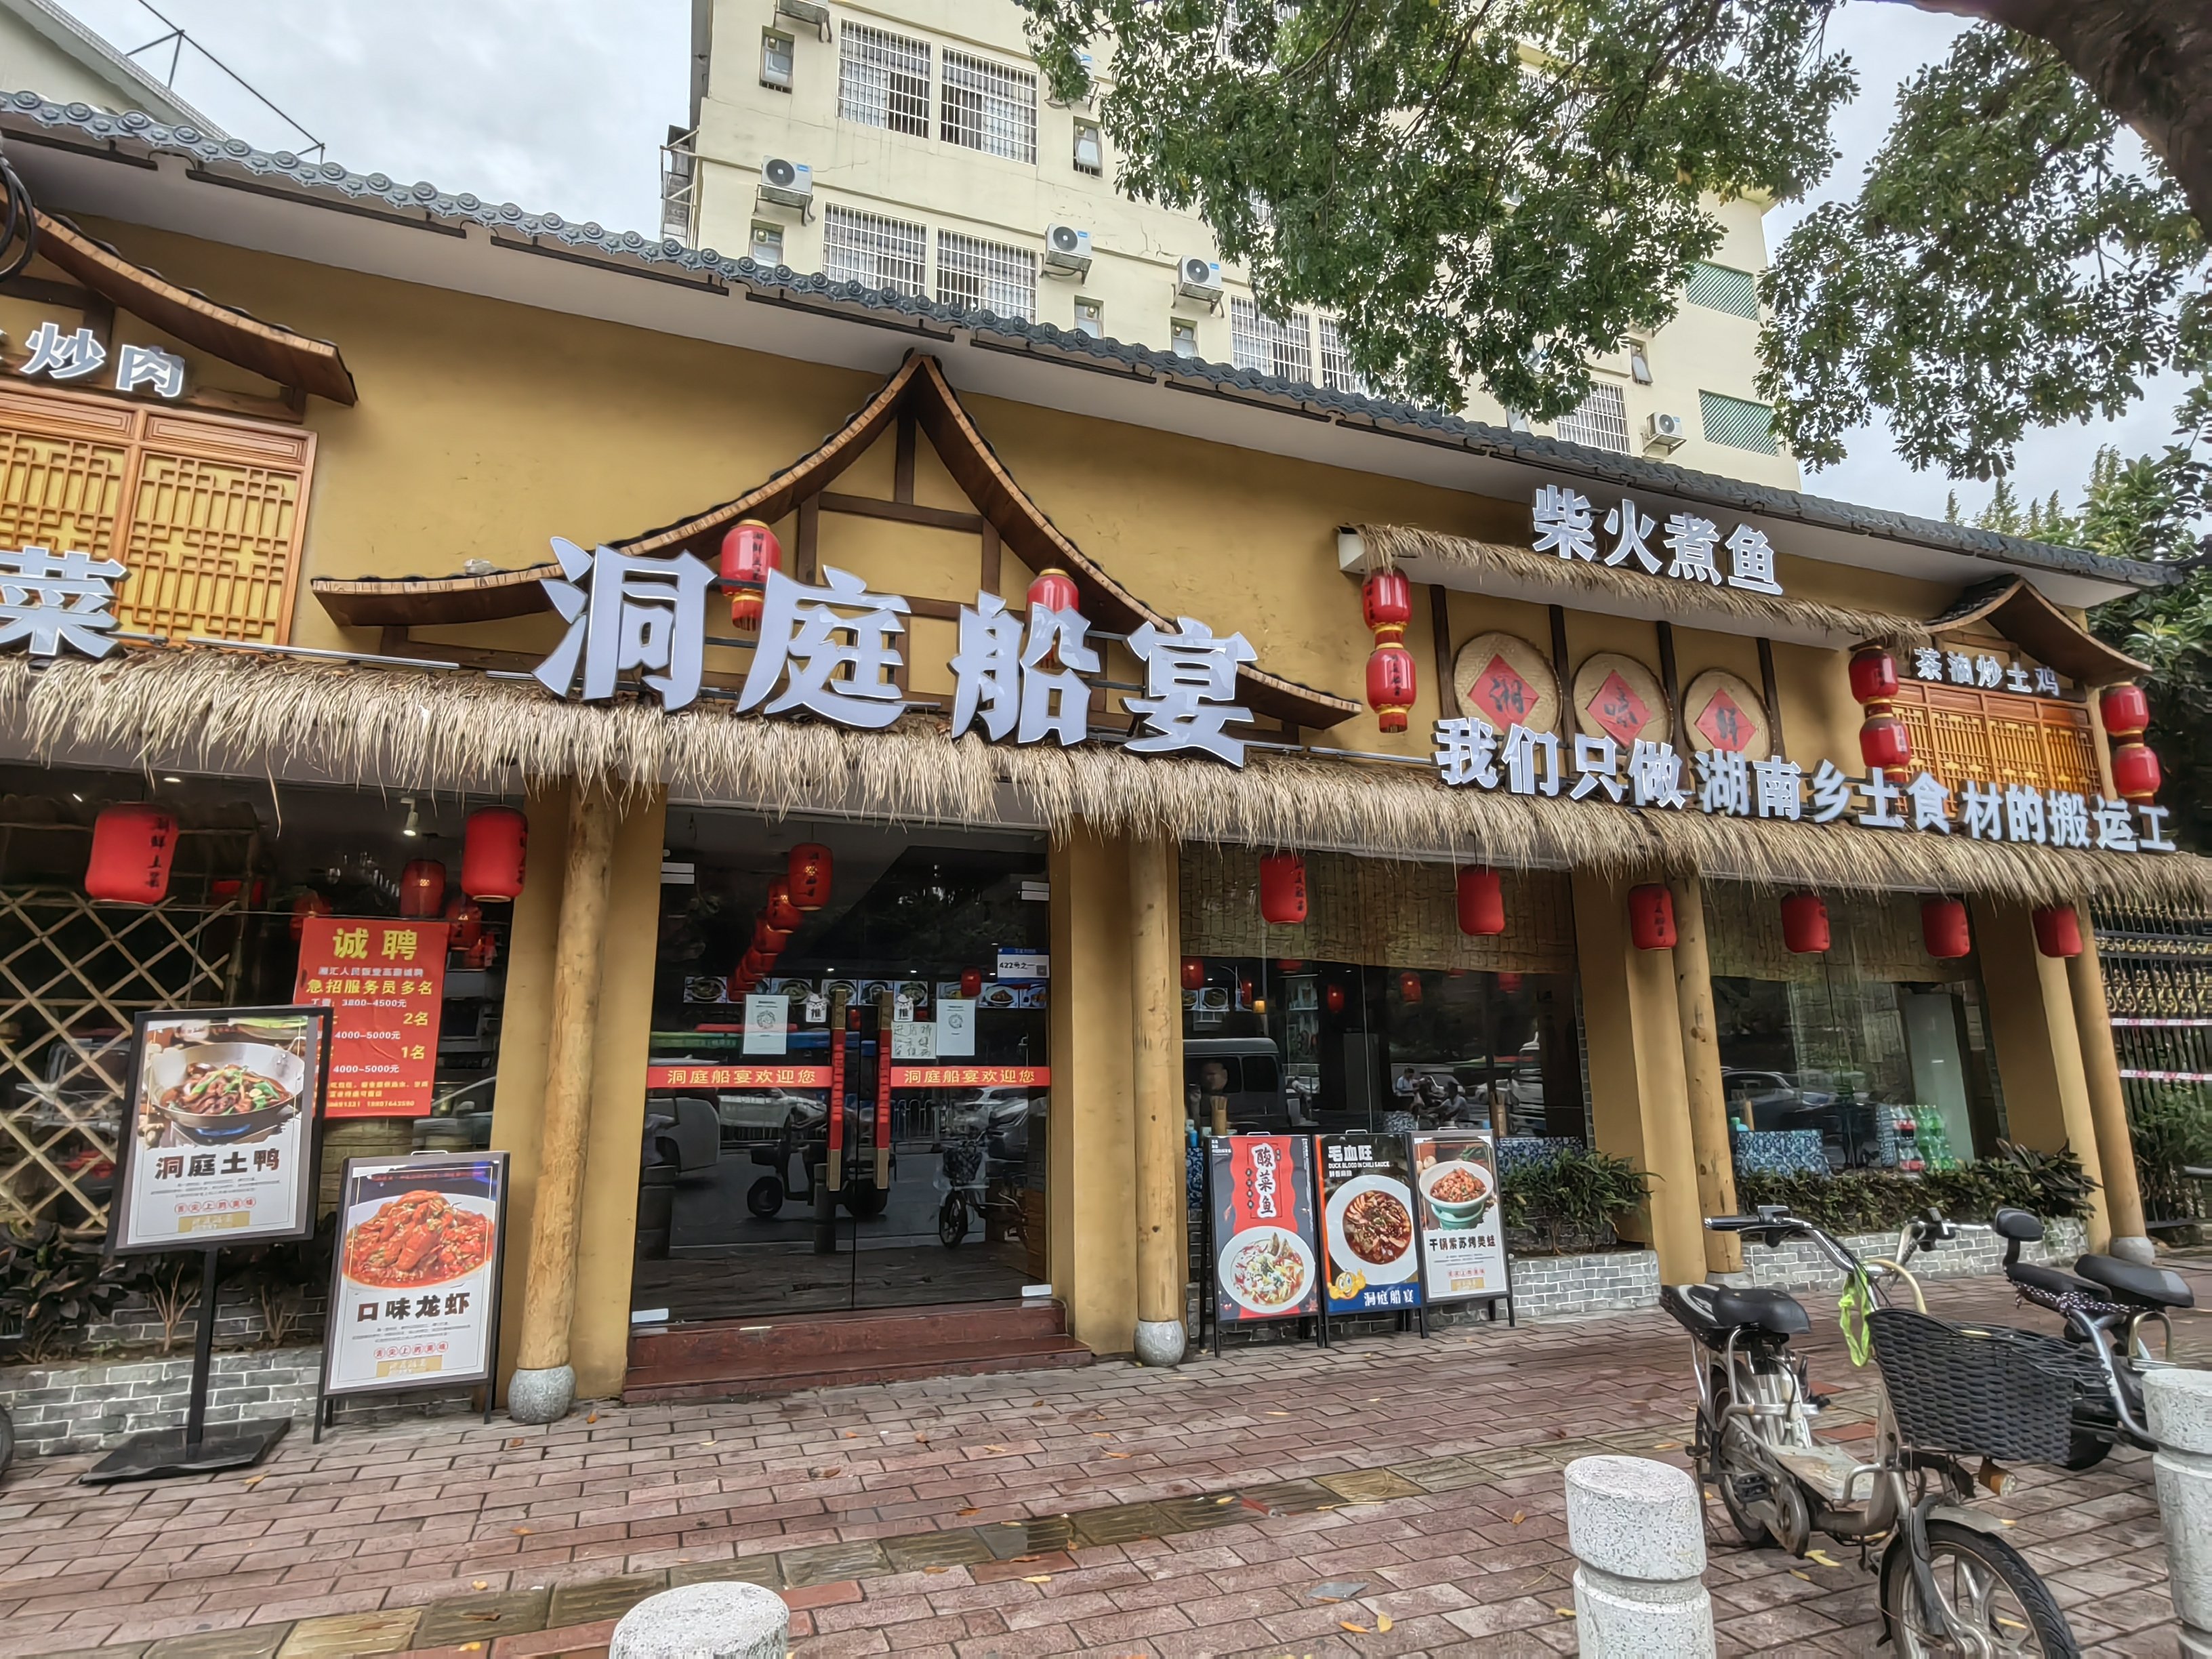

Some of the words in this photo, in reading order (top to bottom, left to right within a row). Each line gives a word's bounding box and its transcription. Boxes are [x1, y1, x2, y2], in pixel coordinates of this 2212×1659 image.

[0, 321, 186, 397] 炒肉
[1532, 483, 1783, 595] 柴火煮鱼
[0, 546, 131, 659] 菜
[531, 535, 1258, 769] 洞庭船宴
[1913, 647, 2060, 697] 茶油炒土鸡
[1432, 717, 2176, 852] 我们只做湖南乡土食材的搬运工
[332, 927, 417, 961] 诚聘
[306, 979, 434, 996] 急招服务员多名
[403, 1012, 428, 1026] 2名
[401, 1044, 426, 1060] 1名
[667, 1069, 816, 1084] 洞庭船宴欢迎您
[903, 1069, 1036, 1084] 洞庭船宴欢迎您
[155, 1147, 280, 1181] 洞庭土鸭
[1328, 1145, 1373, 1162] 毛血旺
[1254, 1147, 1273, 1214] 酸菜鱼
[357, 1292, 470, 1322] 口味龙虾
